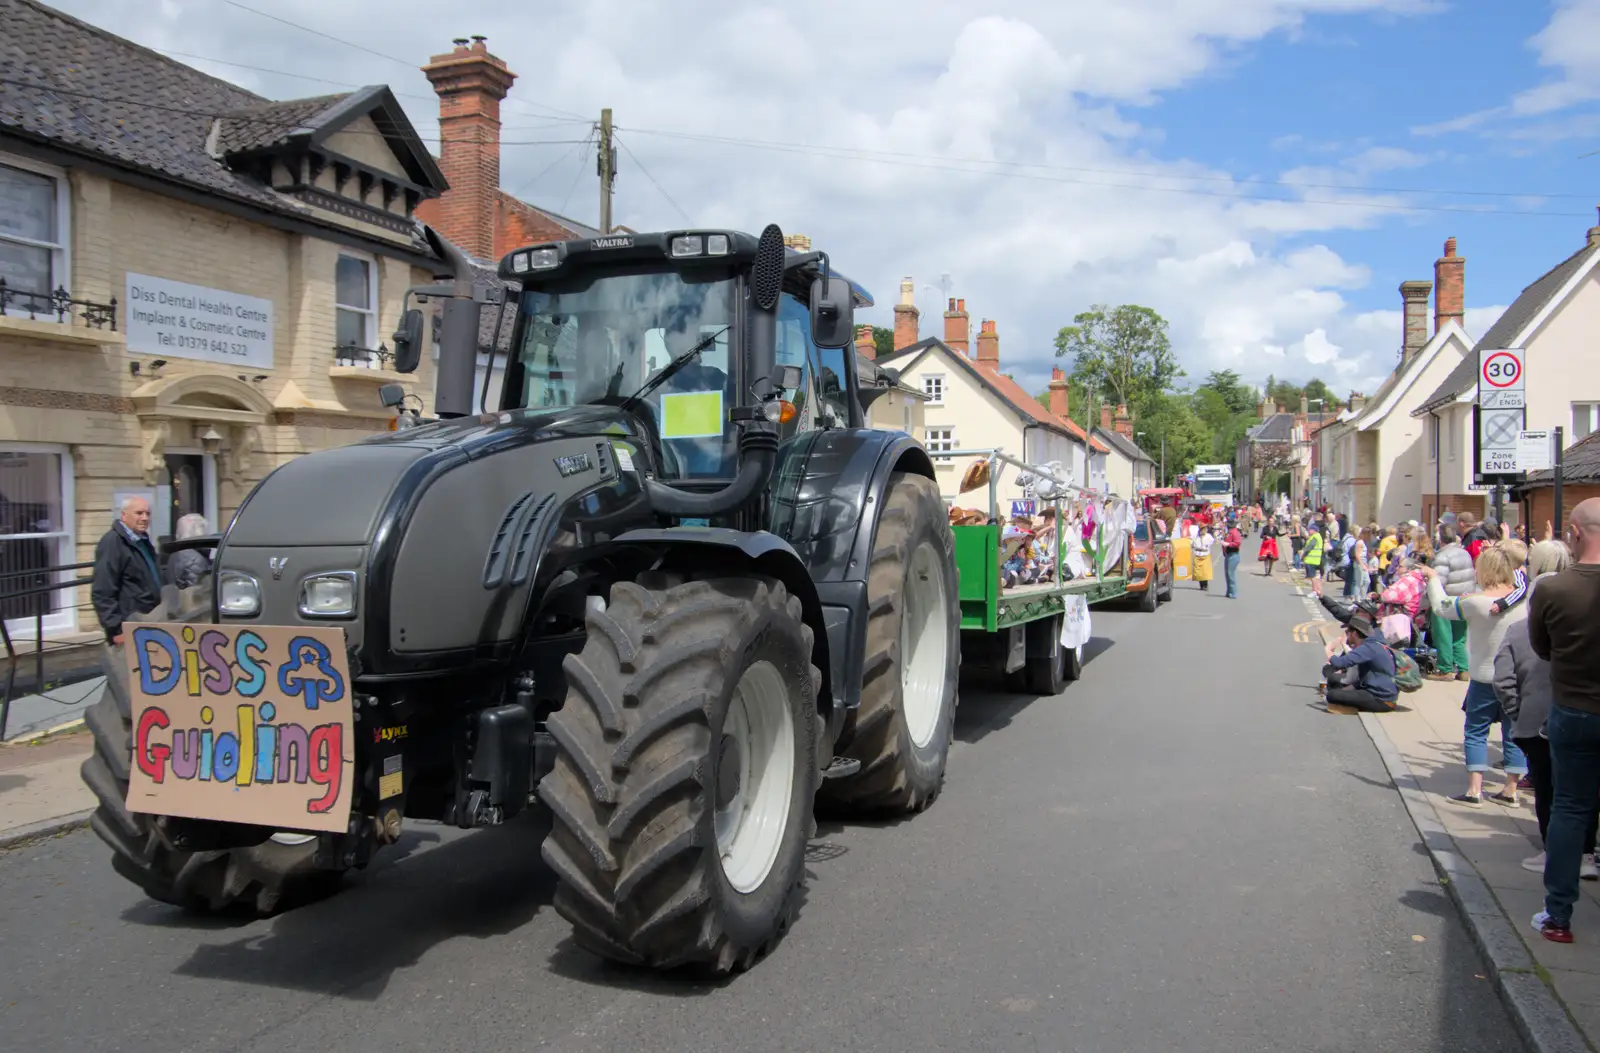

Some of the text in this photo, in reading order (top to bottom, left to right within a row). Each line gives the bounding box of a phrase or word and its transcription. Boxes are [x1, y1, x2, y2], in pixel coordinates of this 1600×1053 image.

[595, 237, 629, 247] VALTRA
[131, 286, 268, 323] Diss Dental Health Centre
[132, 308, 267, 341] Implant & Cosmetic Centre
[157, 332, 248, 357] Tel: 01379 642 522
[1488, 363, 1516, 378] 30
[1485, 461, 1517, 470] ENDS
[1491, 452, 1513, 460] Zone
[134, 700, 344, 813] Guiding
